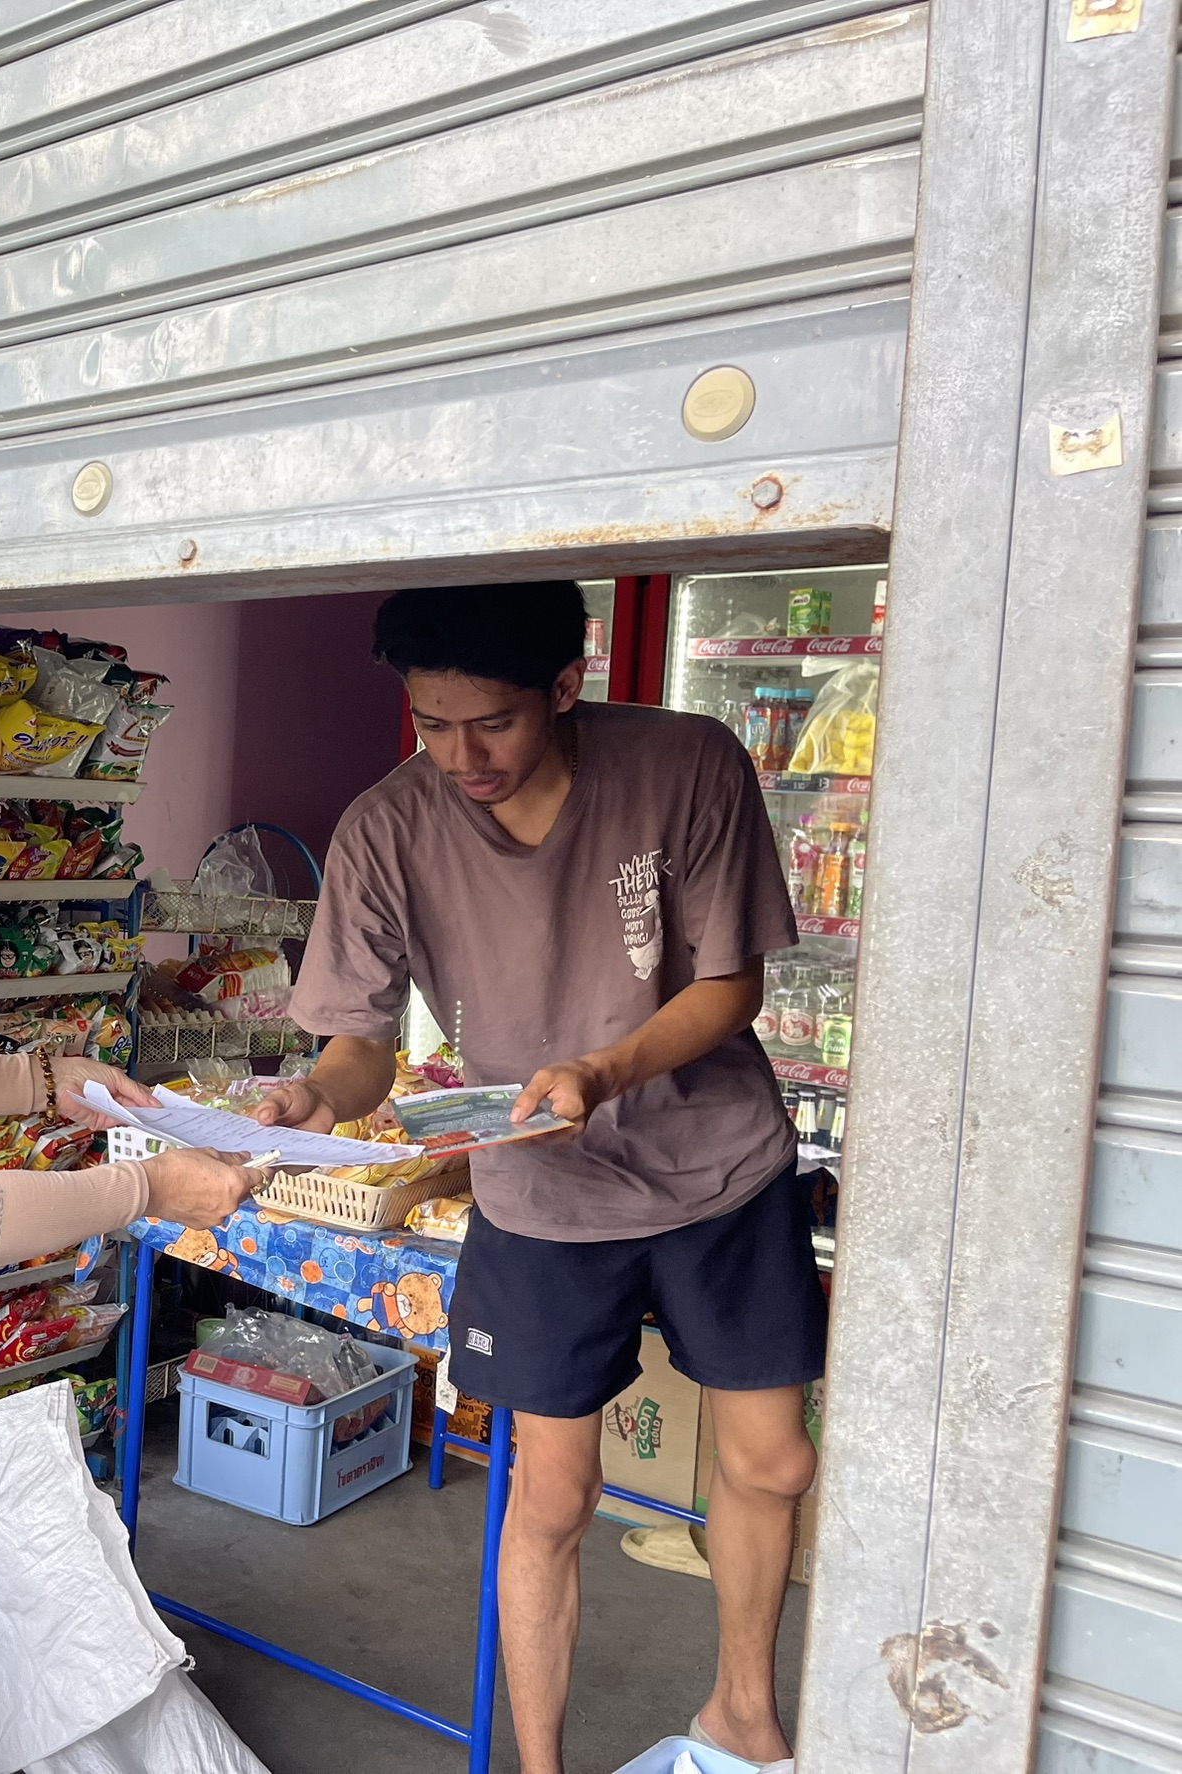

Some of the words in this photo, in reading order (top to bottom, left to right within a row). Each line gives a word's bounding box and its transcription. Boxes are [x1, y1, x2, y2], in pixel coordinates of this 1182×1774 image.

[698, 639, 741, 655] Coca-Cola
[751, 638, 796, 655] Coca-Cola
[807, 638, 853, 653] Coca-Cola
[618, 849, 663, 878] WHAT
[608, 874, 644, 897] THE
[651, 1419, 661, 1445] GOLD
